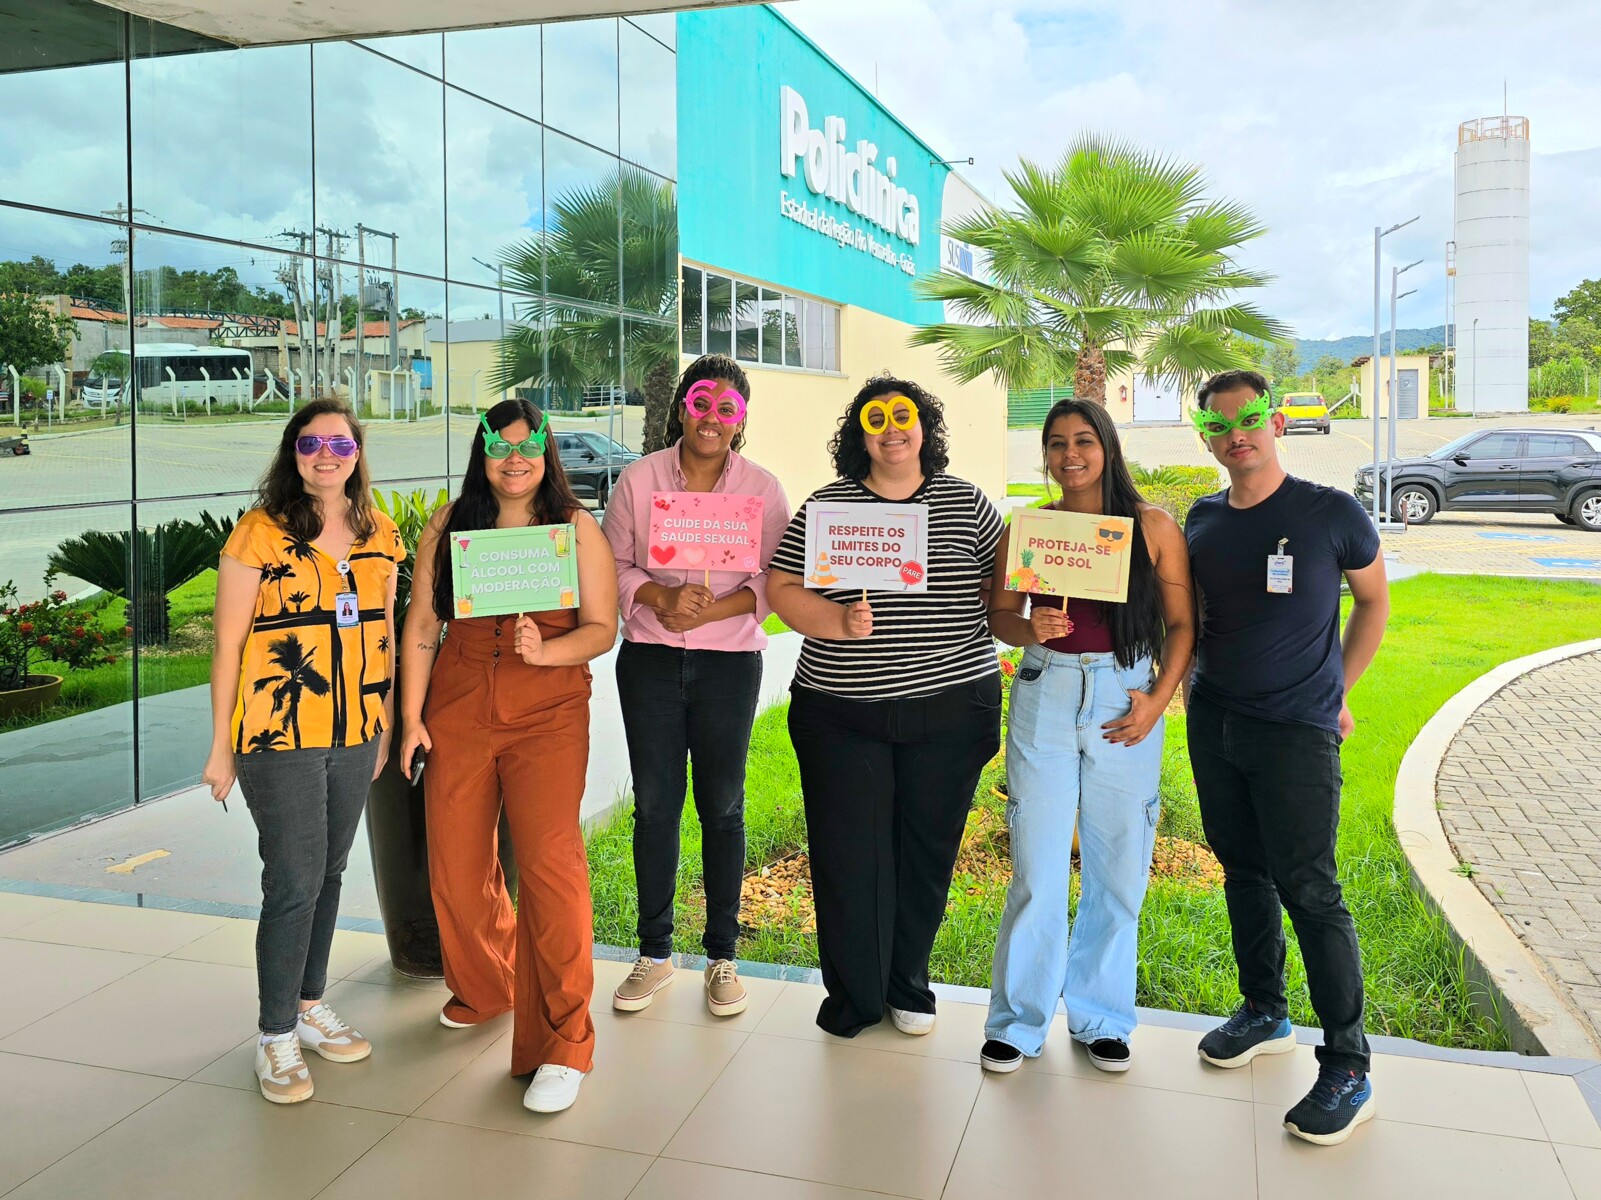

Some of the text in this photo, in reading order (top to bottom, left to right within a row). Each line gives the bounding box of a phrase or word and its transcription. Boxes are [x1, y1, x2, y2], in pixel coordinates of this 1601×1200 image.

[781, 85, 919, 247] Policlínica
[781, 190, 818, 232] Estadual
[829, 216, 855, 248] Região
[947, 238, 960, 269] SUS
[664, 518, 748, 532] CUIDE DA SUA
[828, 525, 905, 538] RESPEITE OS
[661, 530, 750, 545] SAÚDE SEXUAL
[831, 540, 901, 553] LIMITES DO
[1028, 537, 1111, 556] PROTEJA-SE
[479, 547, 550, 562] CONSUMA
[829, 555, 902, 568] SEU CORPO
[1044, 554, 1092, 569] DO SOL
[471, 562, 560, 578] ÁLCOOL COM
[902, 566, 922, 579] PARE
[471, 576, 561, 594] MODERAÇÃO
